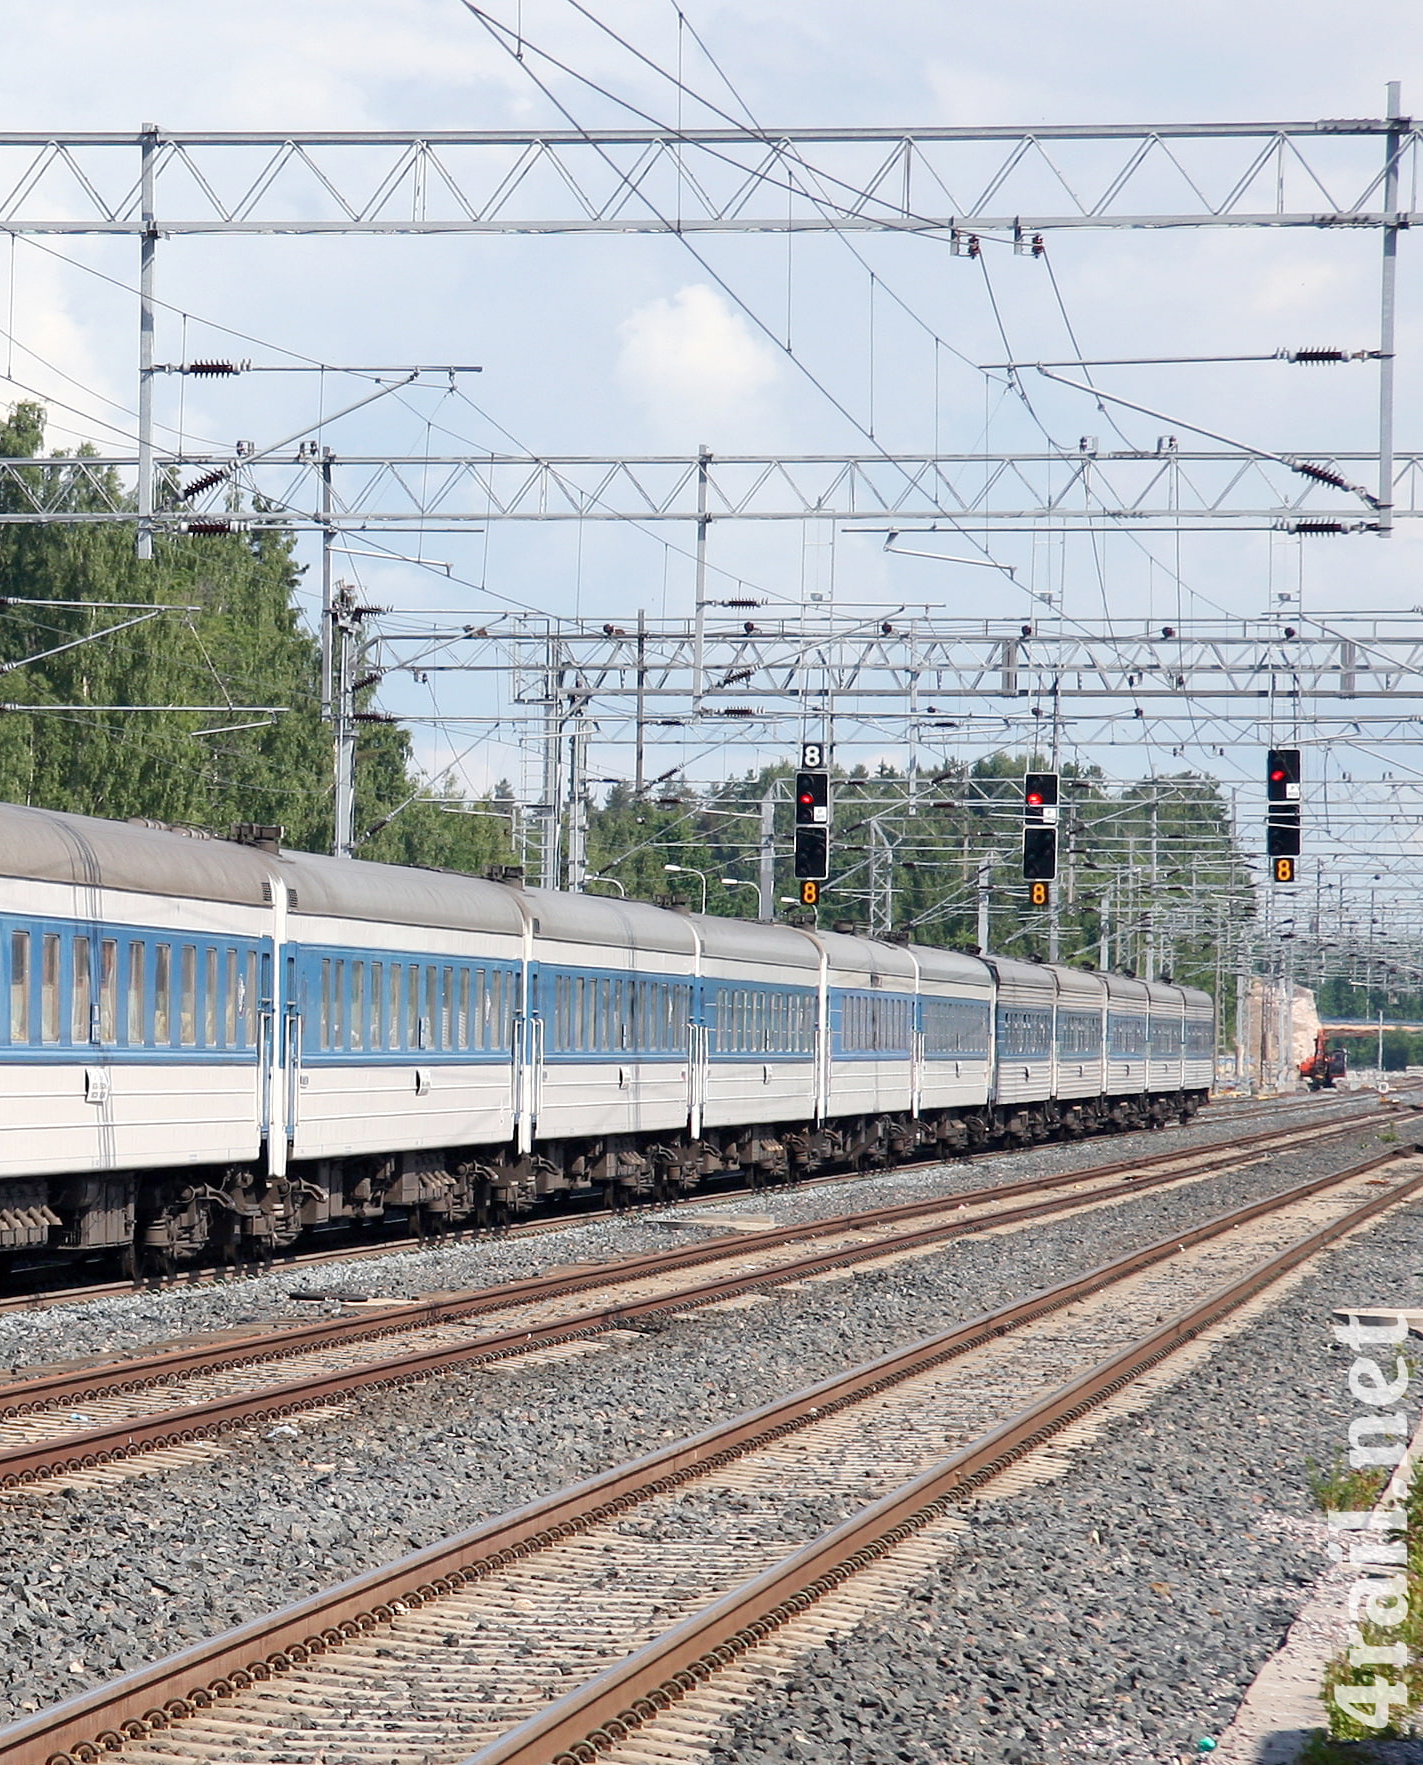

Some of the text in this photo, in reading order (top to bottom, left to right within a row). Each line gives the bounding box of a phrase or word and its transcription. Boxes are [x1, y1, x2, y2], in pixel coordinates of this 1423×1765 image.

[804, 745, 820, 767] 8
[1278, 859, 1291, 881] 8
[803, 881, 816, 904] 8
[1032, 883, 1045, 905] 8
